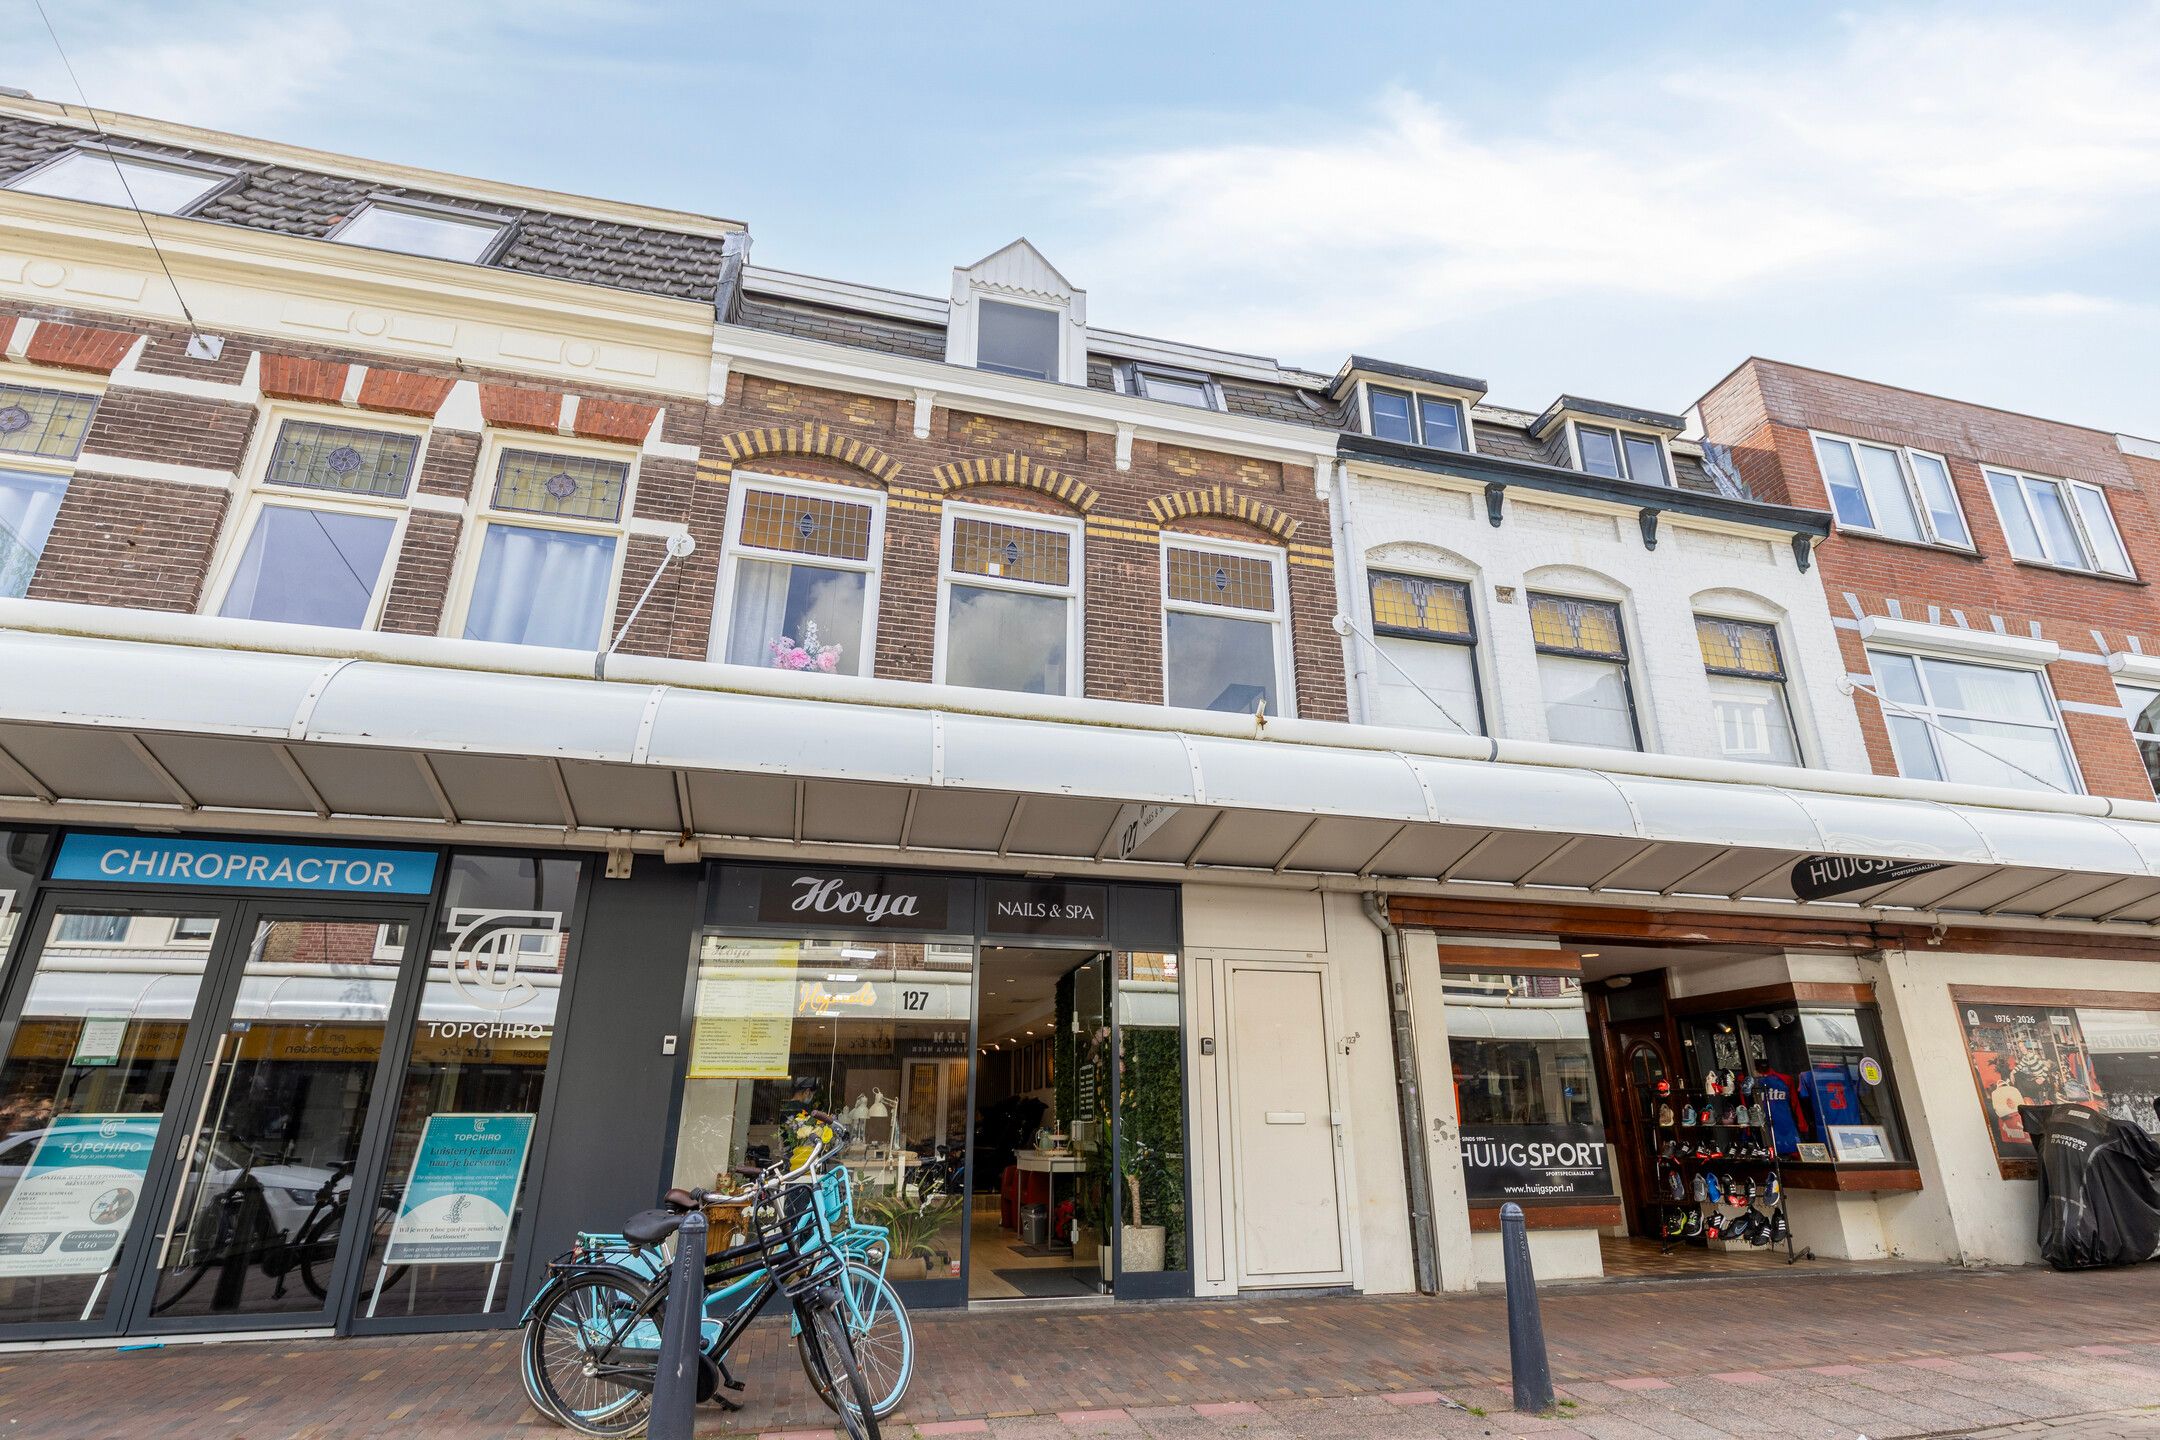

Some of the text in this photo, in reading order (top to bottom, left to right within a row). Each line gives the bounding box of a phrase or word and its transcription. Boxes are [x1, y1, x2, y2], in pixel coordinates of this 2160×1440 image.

[100, 849, 395, 886] CHIROPRACTOR
[791, 876, 920, 922] Hoya
[998, 901, 1095, 920] NAILS & SPA
[902, 991, 929, 1011] 127
[1994, 1015, 2011, 1023] 1976
[2018, 1015, 2036, 1024] 2026
[428, 1022, 544, 1039] TOPCHIRO
[1826, 1082, 1848, 1110] 3
[454, 1133, 501, 1141] TOPCHIRO
[2050, 1138, 2085, 1152] RAINEX
[62, 1142, 142, 1153] TOPCHIRO
[1461, 1143, 1604, 1167] HUIJGSPORT
[1504, 1183, 1574, 1195] www.huijgsport.nl
